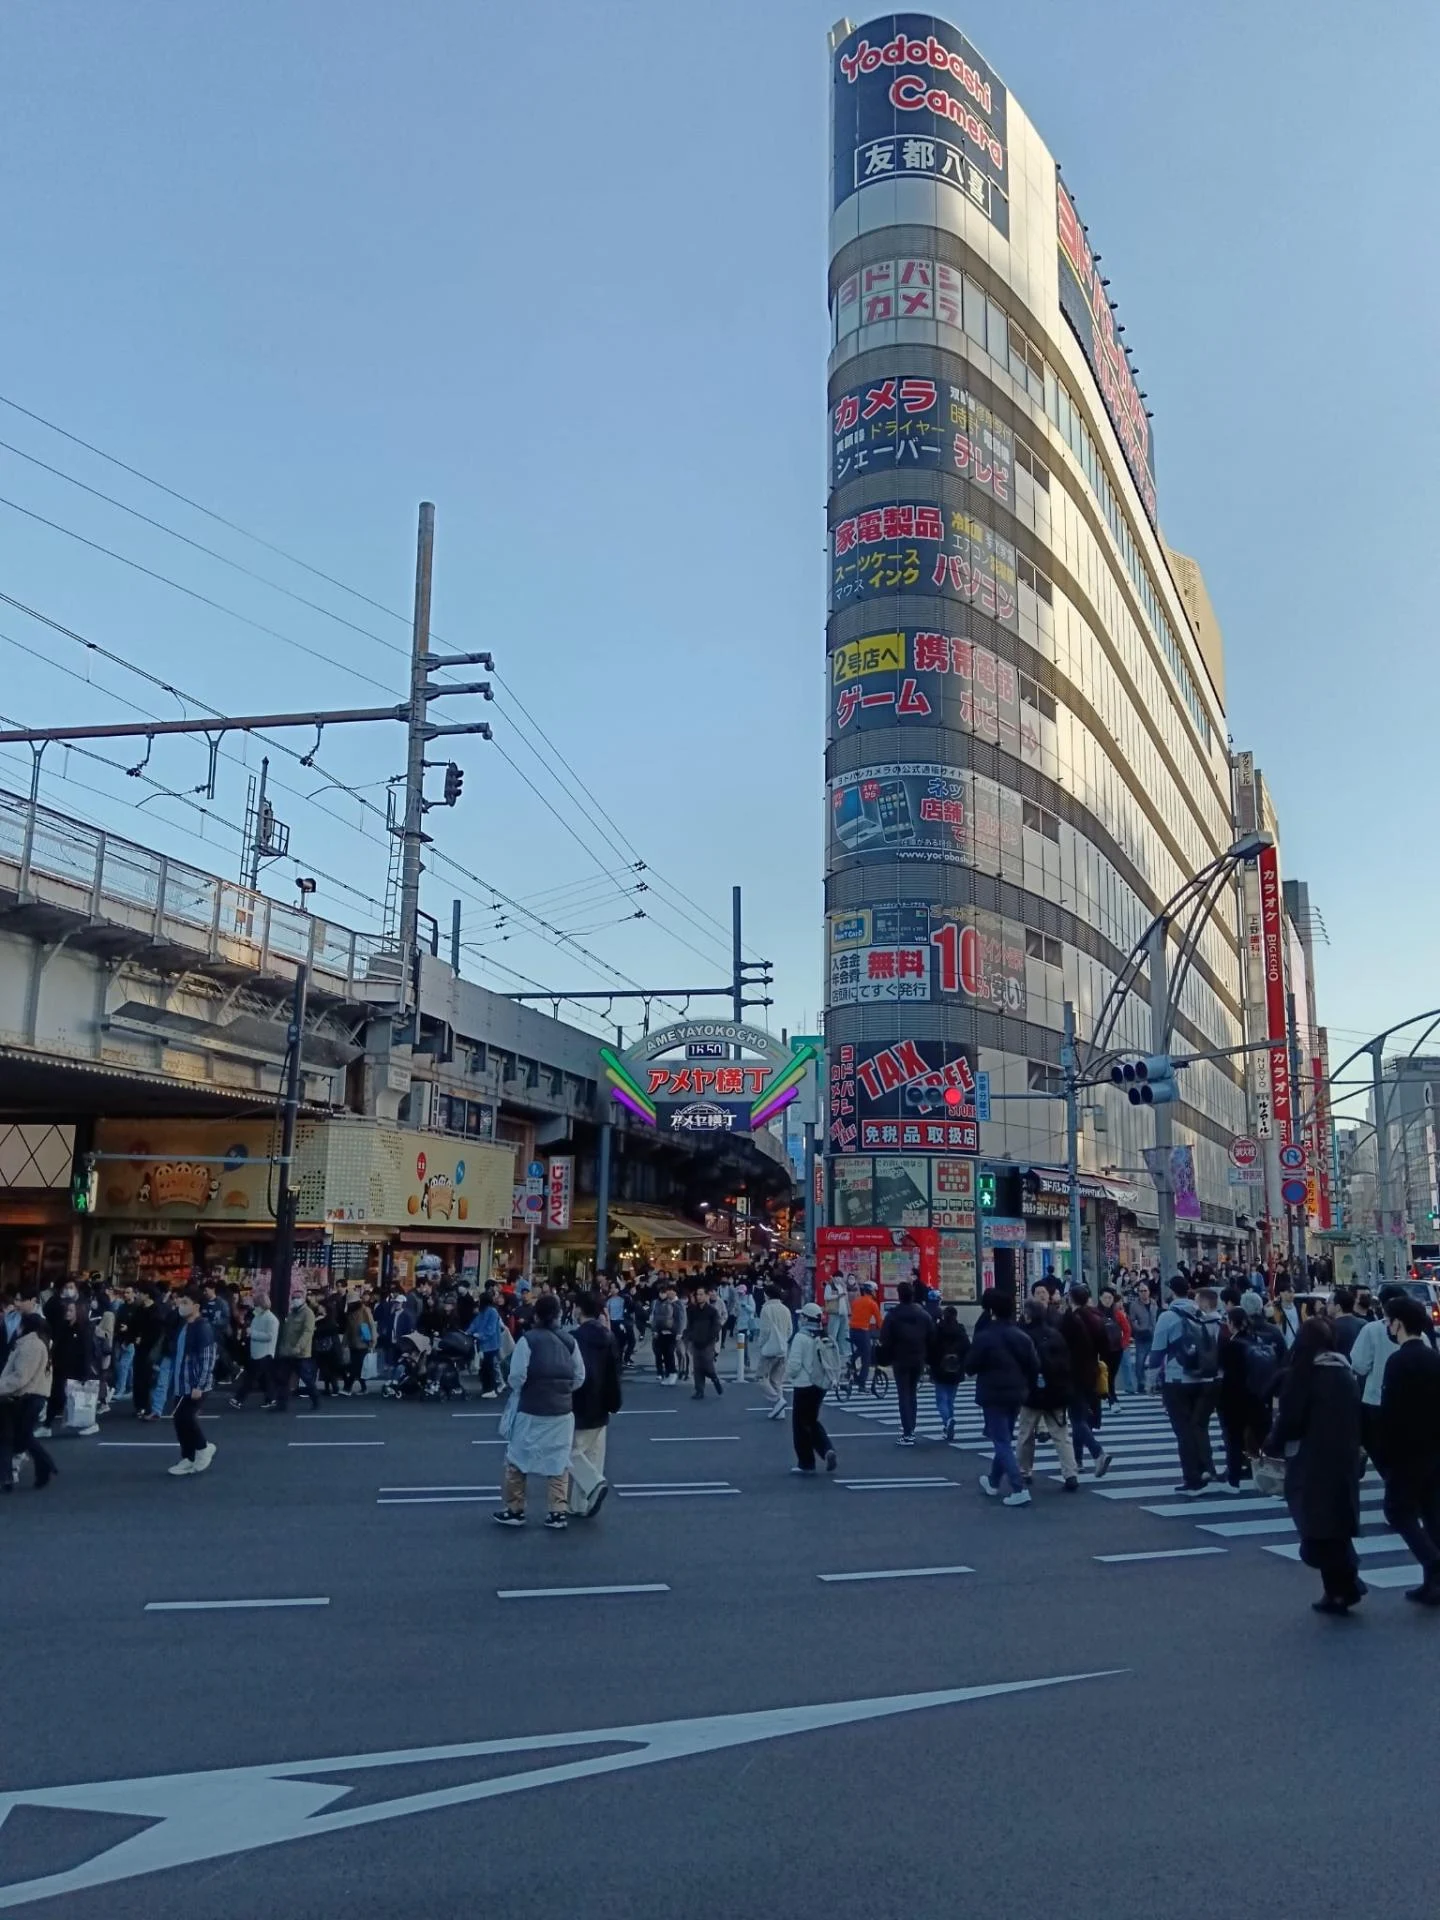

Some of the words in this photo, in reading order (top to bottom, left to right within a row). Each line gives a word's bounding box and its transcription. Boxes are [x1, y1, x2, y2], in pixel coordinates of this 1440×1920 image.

[840, 34, 992, 113] Yodobashi
[889, 74, 1004, 170] Camera
[865, 139, 986, 206] 友都八喜
[865, 289, 958, 323] カメラ
[834, 379, 937, 435] カメラ
[871, 420, 945, 440] ドライヤー
[837, 437, 942, 479] シェーバー
[953, 433, 1009, 501] テレビ
[835, 506, 944, 557] 家電製品
[835, 549, 920, 583] スーツケース
[868, 568, 920, 588] インク
[932, 553, 1014, 618] パソコン
[834, 646, 899, 682] 2号店へ
[913, 632, 1015, 704] 携帯電話
[836, 679, 931, 728] ゲーム
[1264, 869, 1278, 922] カラオケ
[832, 953, 860, 971] 入会金
[867, 949, 924, 979] 無料
[832, 983, 927, 1003] 店頭にてすぐ発行
[646, 1025, 769, 1051] AMEYAYOKOCHO
[646, 1066, 773, 1095] アメヤ横丁
[831, 1065, 841, 1116] カメラ
[841, 1045, 854, 1115] ヨドバシ
[857, 1039, 931, 1100] TAX
[1257, 1057, 1266, 1088] NUOVO
[1273, 1053, 1289, 1107] カラオケ
[670, 1114, 738, 1127] アメヤ横丁
[865, 1125, 975, 1146] 免税品取扱店
[905, 1199, 926, 1210] VISA
